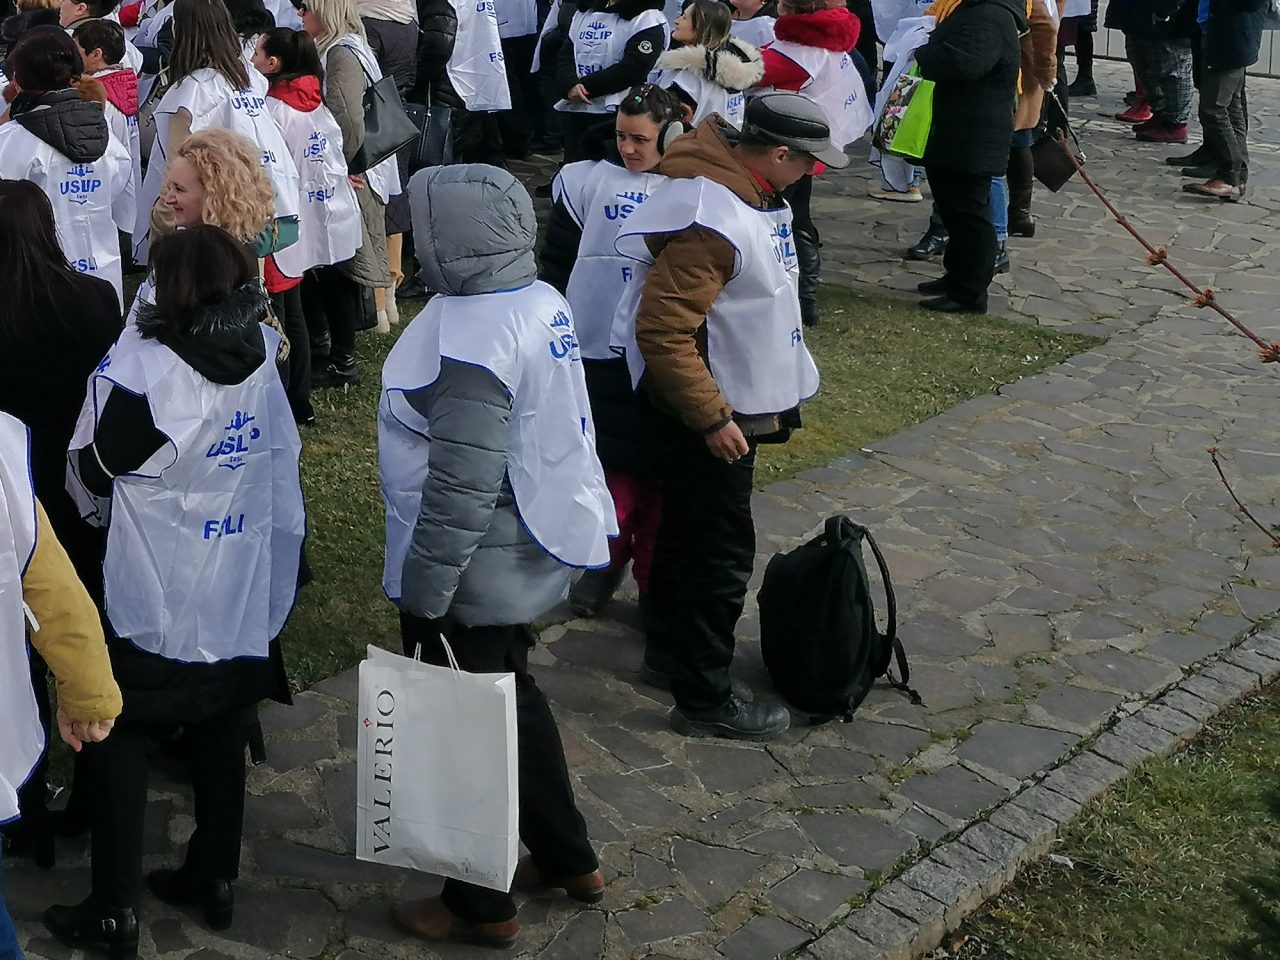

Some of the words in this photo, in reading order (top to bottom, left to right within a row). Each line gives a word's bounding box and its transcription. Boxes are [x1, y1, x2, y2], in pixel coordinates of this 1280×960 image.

[579, 30, 613, 41] USLIP
[203, 513, 245, 540] FLI
[373, 689, 396, 855] VALERIO
